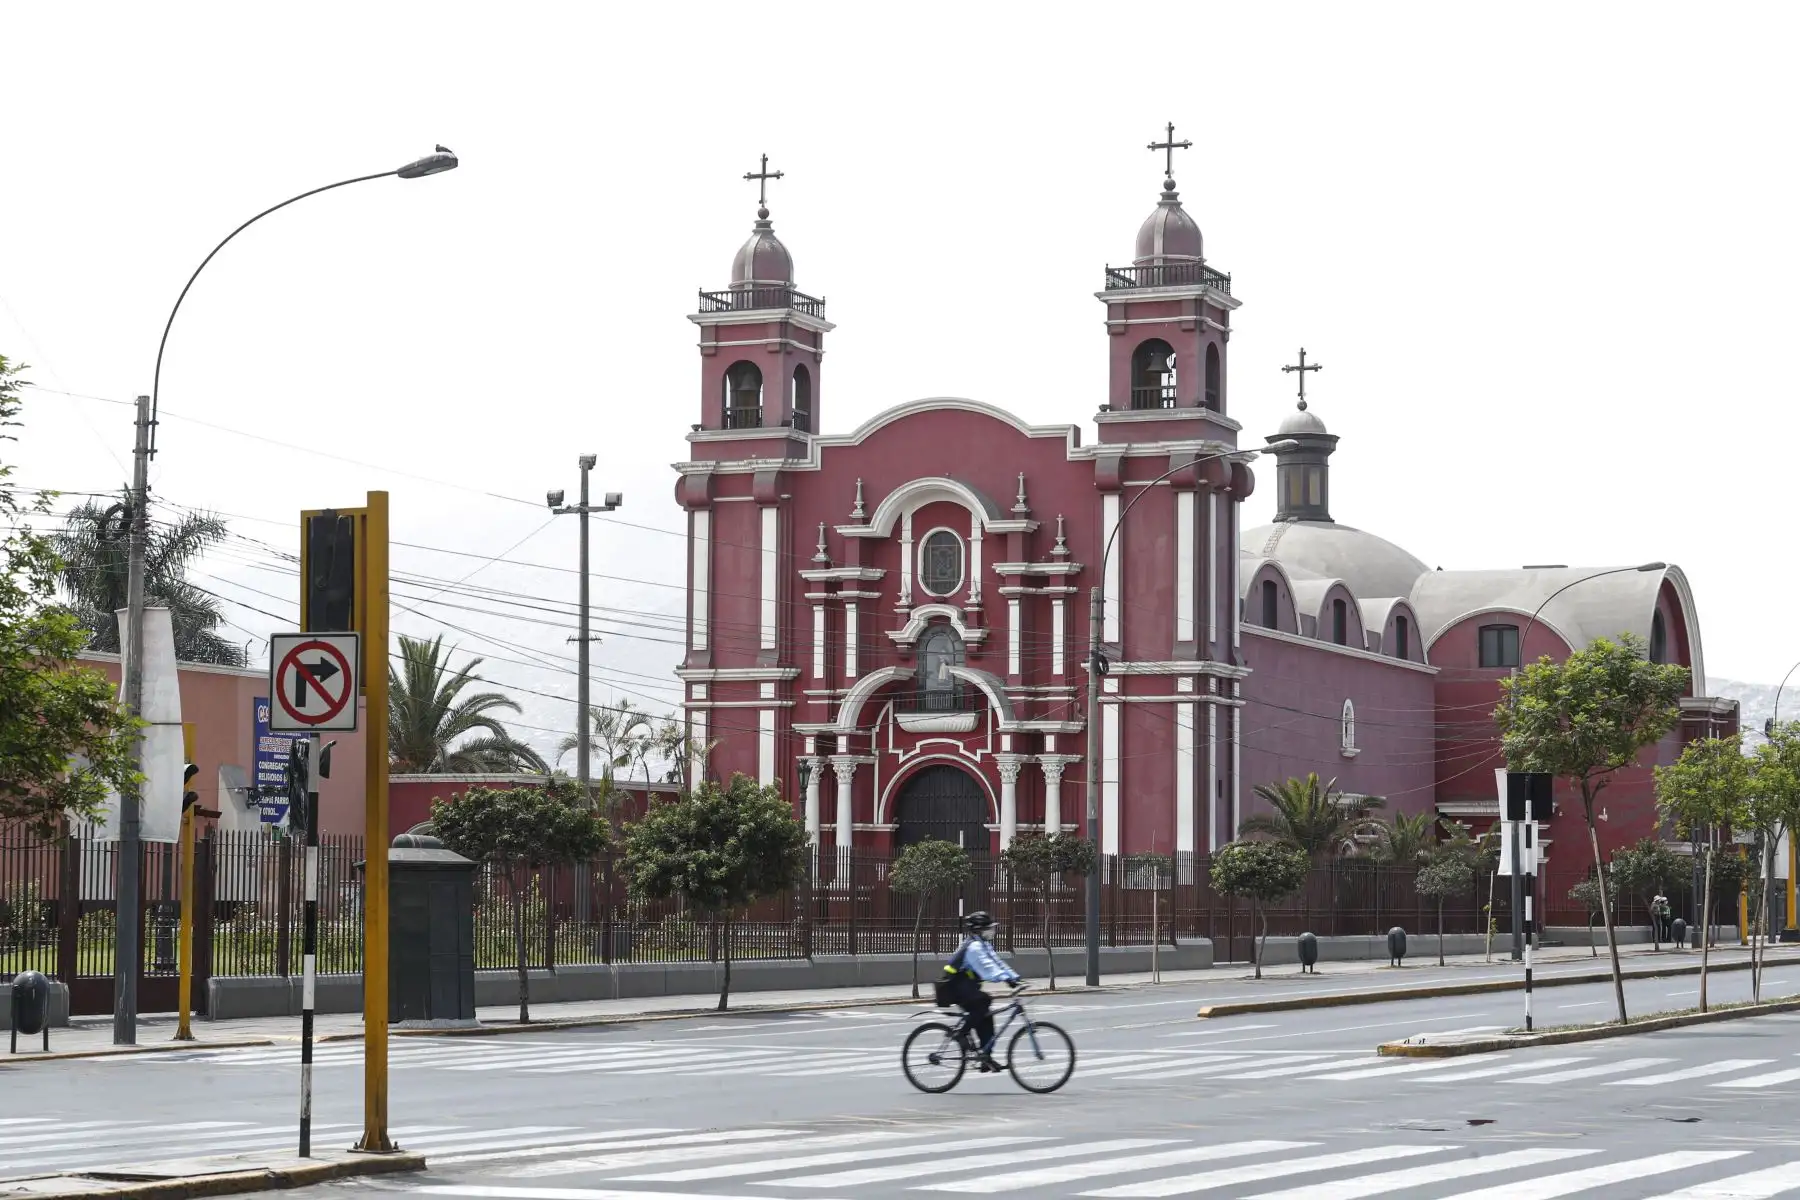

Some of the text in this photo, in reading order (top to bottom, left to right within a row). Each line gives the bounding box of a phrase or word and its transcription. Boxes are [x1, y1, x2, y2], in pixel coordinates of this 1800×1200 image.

[258, 761, 289, 771] CONGREGAC
[258, 772, 283, 782] RELIGIOSOS
[274, 796, 290, 805] PARRO
